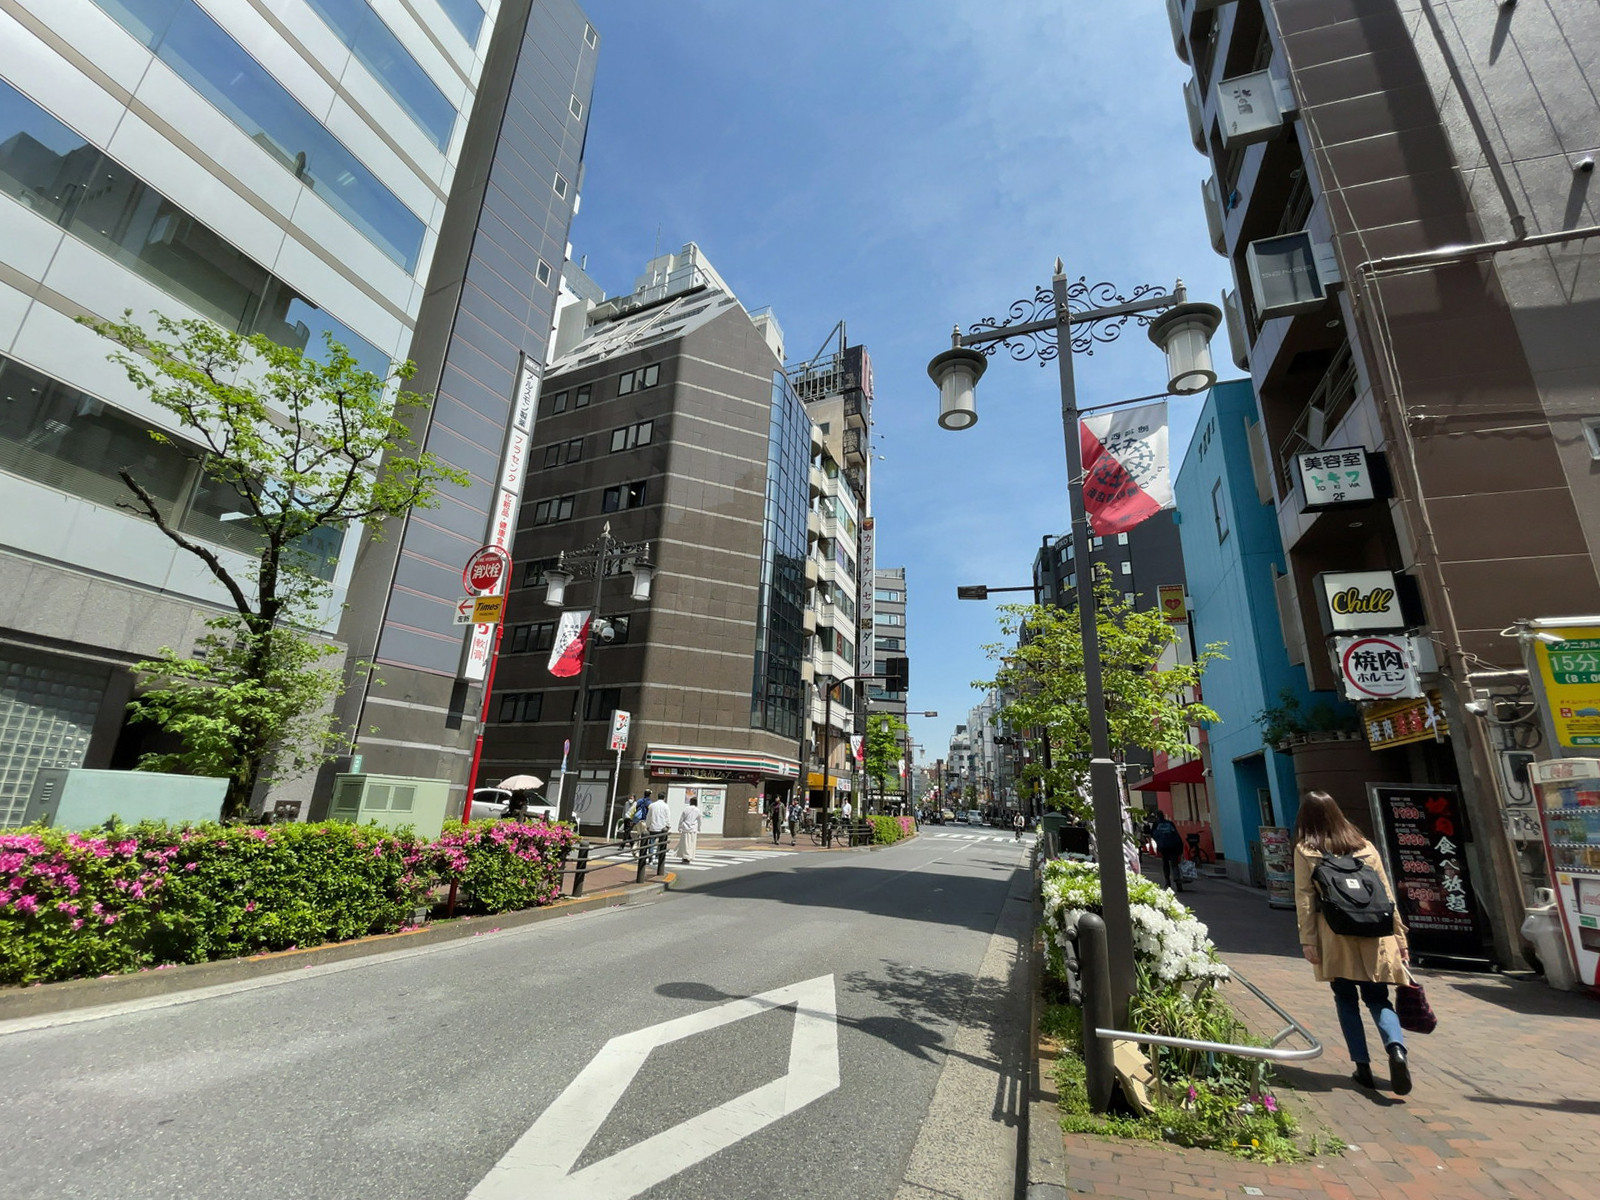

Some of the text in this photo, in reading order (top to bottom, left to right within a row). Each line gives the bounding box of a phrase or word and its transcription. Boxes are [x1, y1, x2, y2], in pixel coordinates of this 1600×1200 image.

[1304, 452, 1362, 472] 美容室
[1311, 470, 1360, 486] トキワ
[1333, 492, 1346, 501] 2F
[472, 563, 501, 580] 消火栓
[476, 602, 501, 611] Times
[1332, 587, 1394, 614] Chill
[862, 631, 873, 670] ダーツ
[1351, 650, 1405, 672] 焼肉
[1550, 653, 1599, 672] 15分
[1357, 671, 1406, 683] ホルモン
[1434, 836, 1469, 913] 食べ放題
